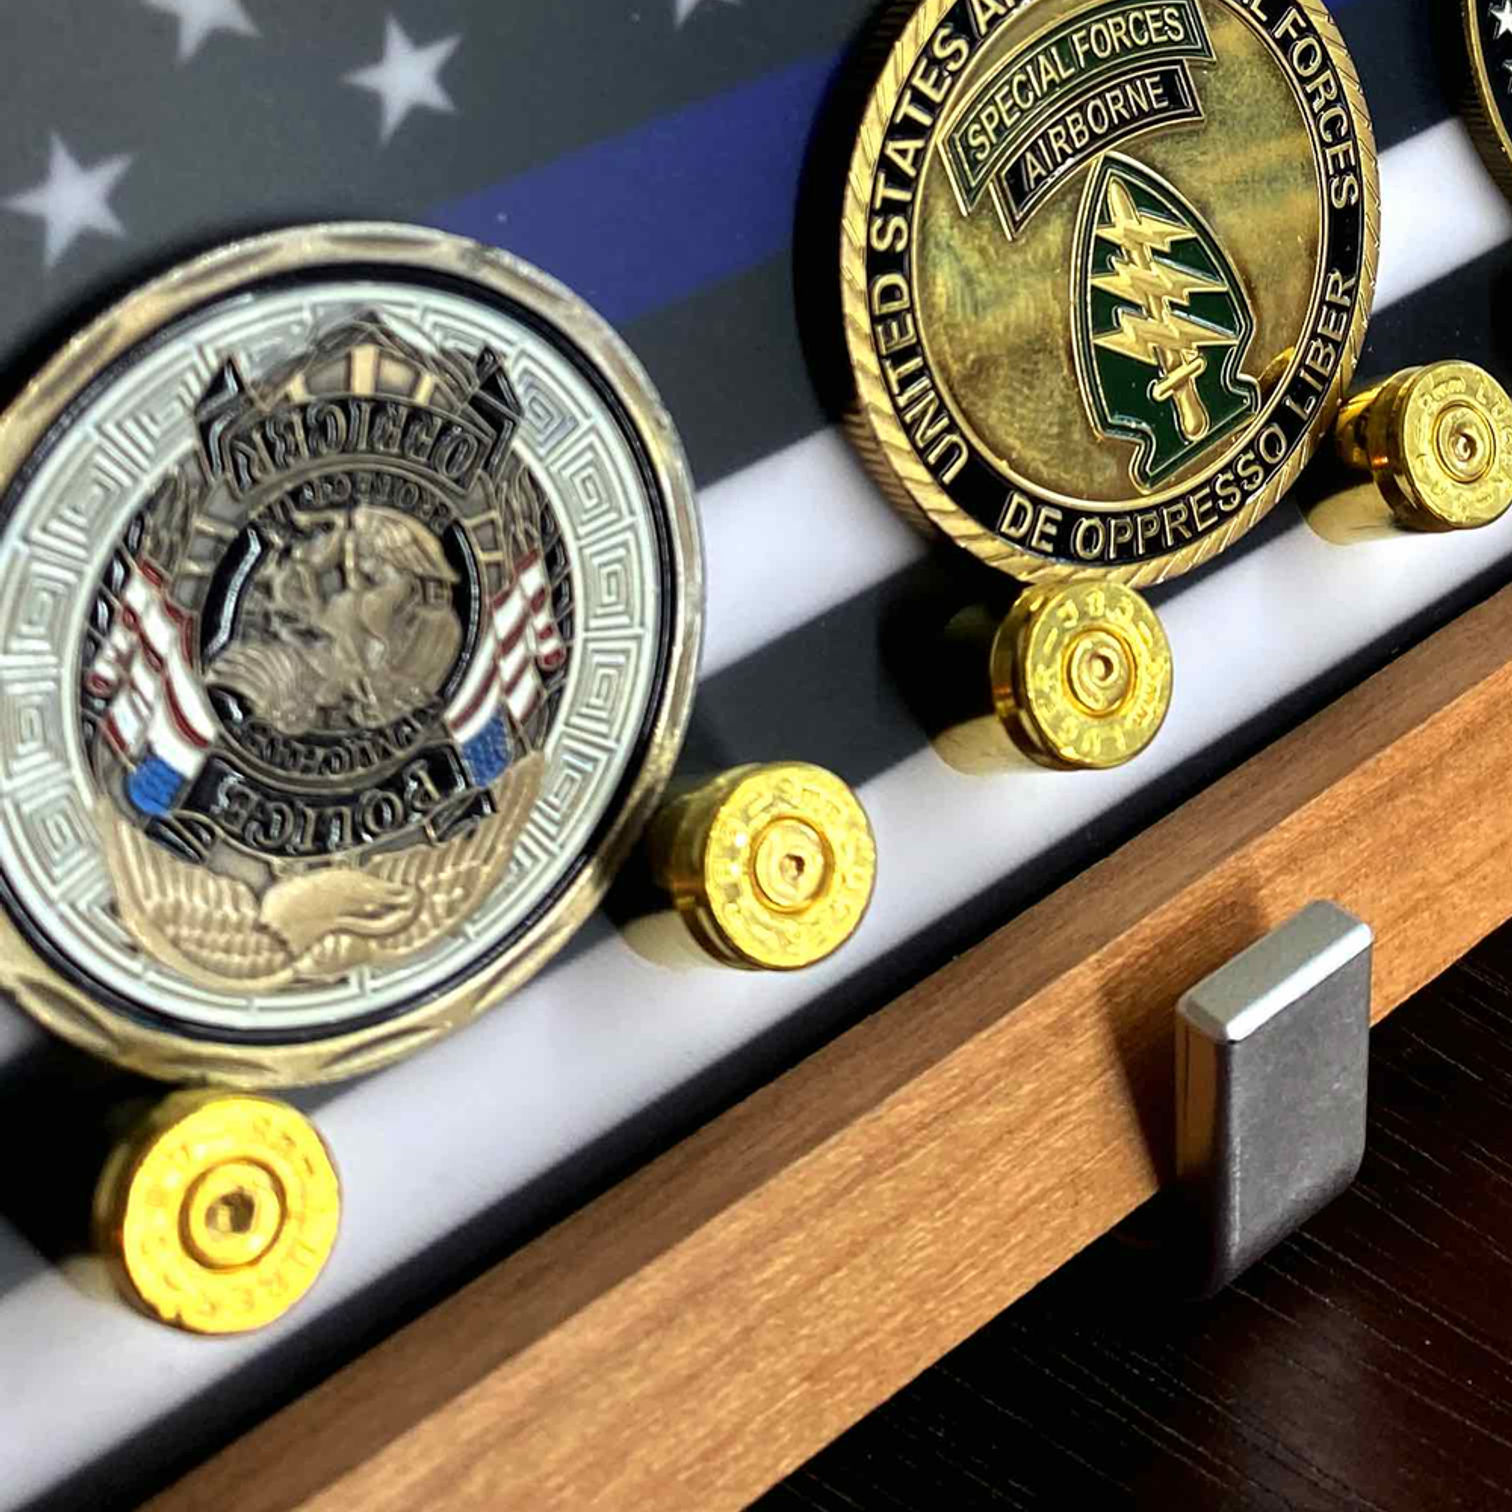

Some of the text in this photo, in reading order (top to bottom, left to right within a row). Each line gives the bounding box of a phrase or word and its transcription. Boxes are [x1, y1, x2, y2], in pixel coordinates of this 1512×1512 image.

[869, 25, 970, 256] STATES
[968, 5, 1186, 161] SPECIAL FORCES
[1024, 75, 1170, 191] AIRBORNE
[1272, 7, 1360, 211] FORCES
[232, 400, 484, 490] OFFICER
[873, 269, 970, 487] UNITED
[1001, 490, 1063, 555] DE
[1072, 425, 1288, 562] OPPRESSO
[1284, 271, 1357, 436] LIBER
[214, 763, 454, 855] POLICE
